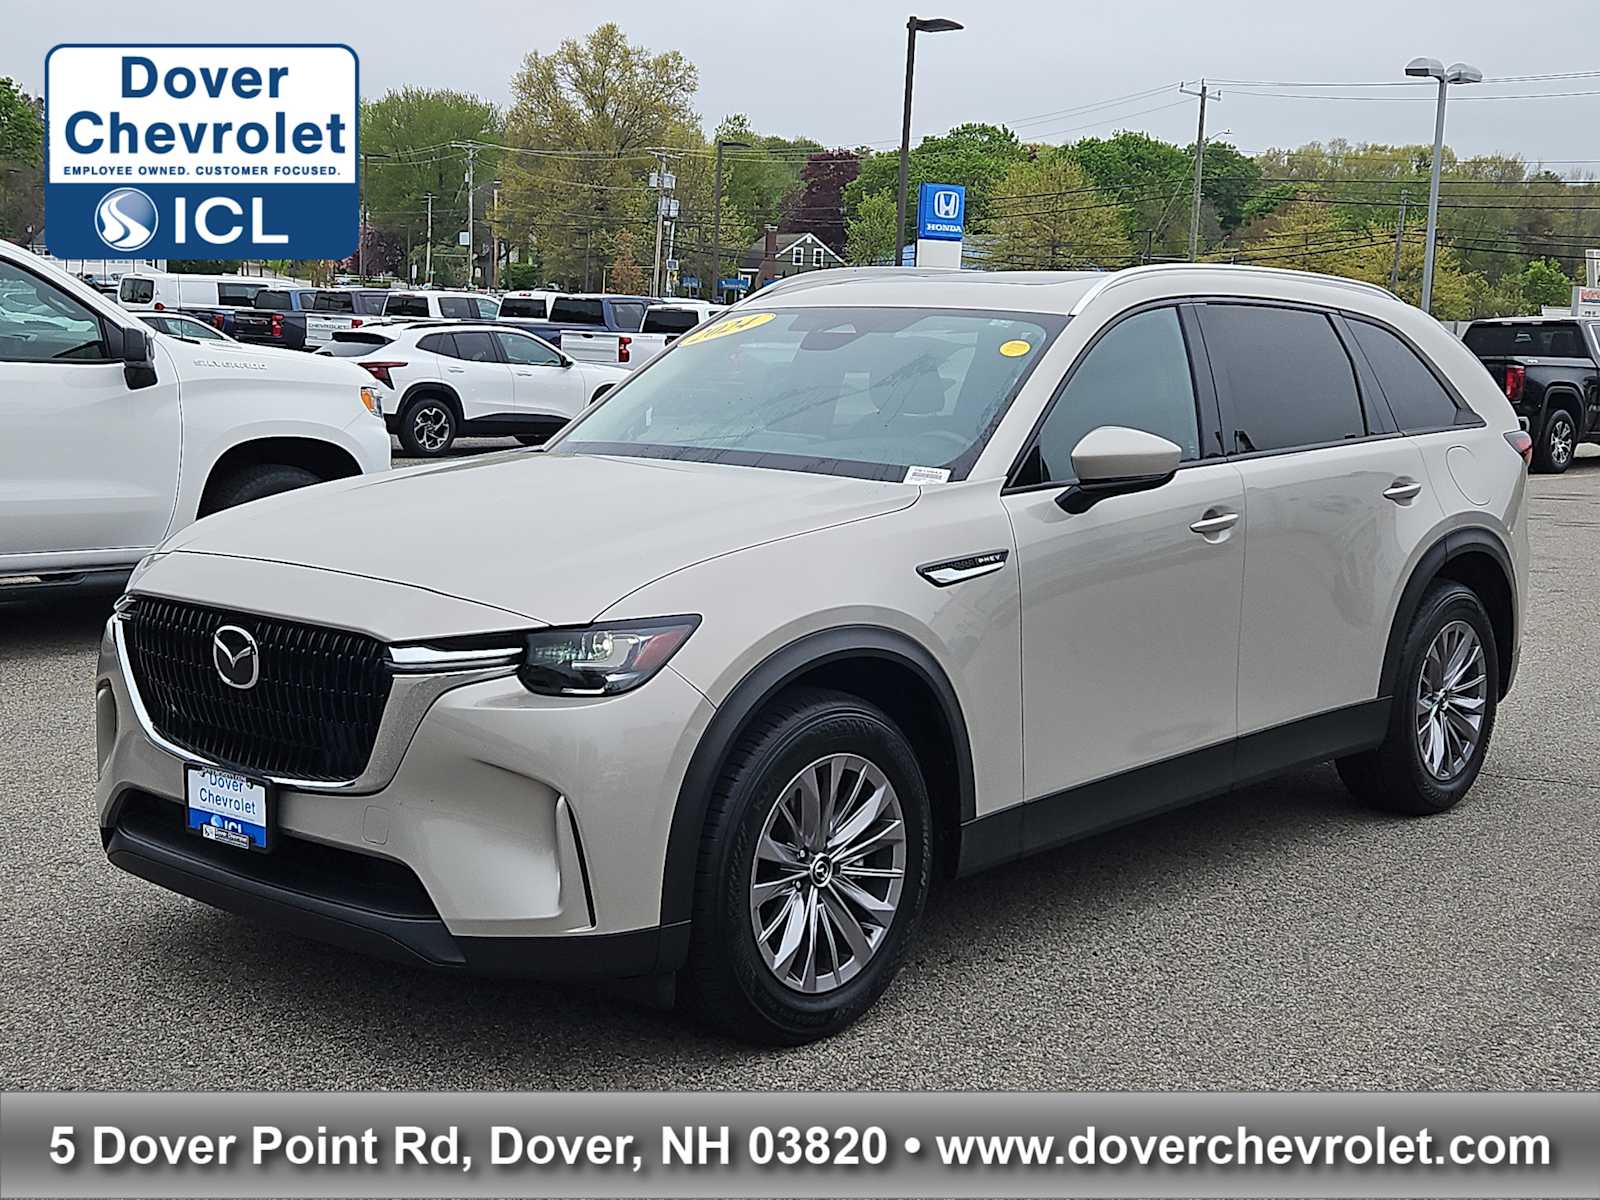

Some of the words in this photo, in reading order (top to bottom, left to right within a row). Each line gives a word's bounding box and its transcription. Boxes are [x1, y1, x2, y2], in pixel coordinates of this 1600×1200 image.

[926, 223, 962, 232] HONDA
[193, 360, 269, 370] SILVERADO
[977, 554, 1001, 564] PHEV
[199, 787, 256, 815] Chevrolet
